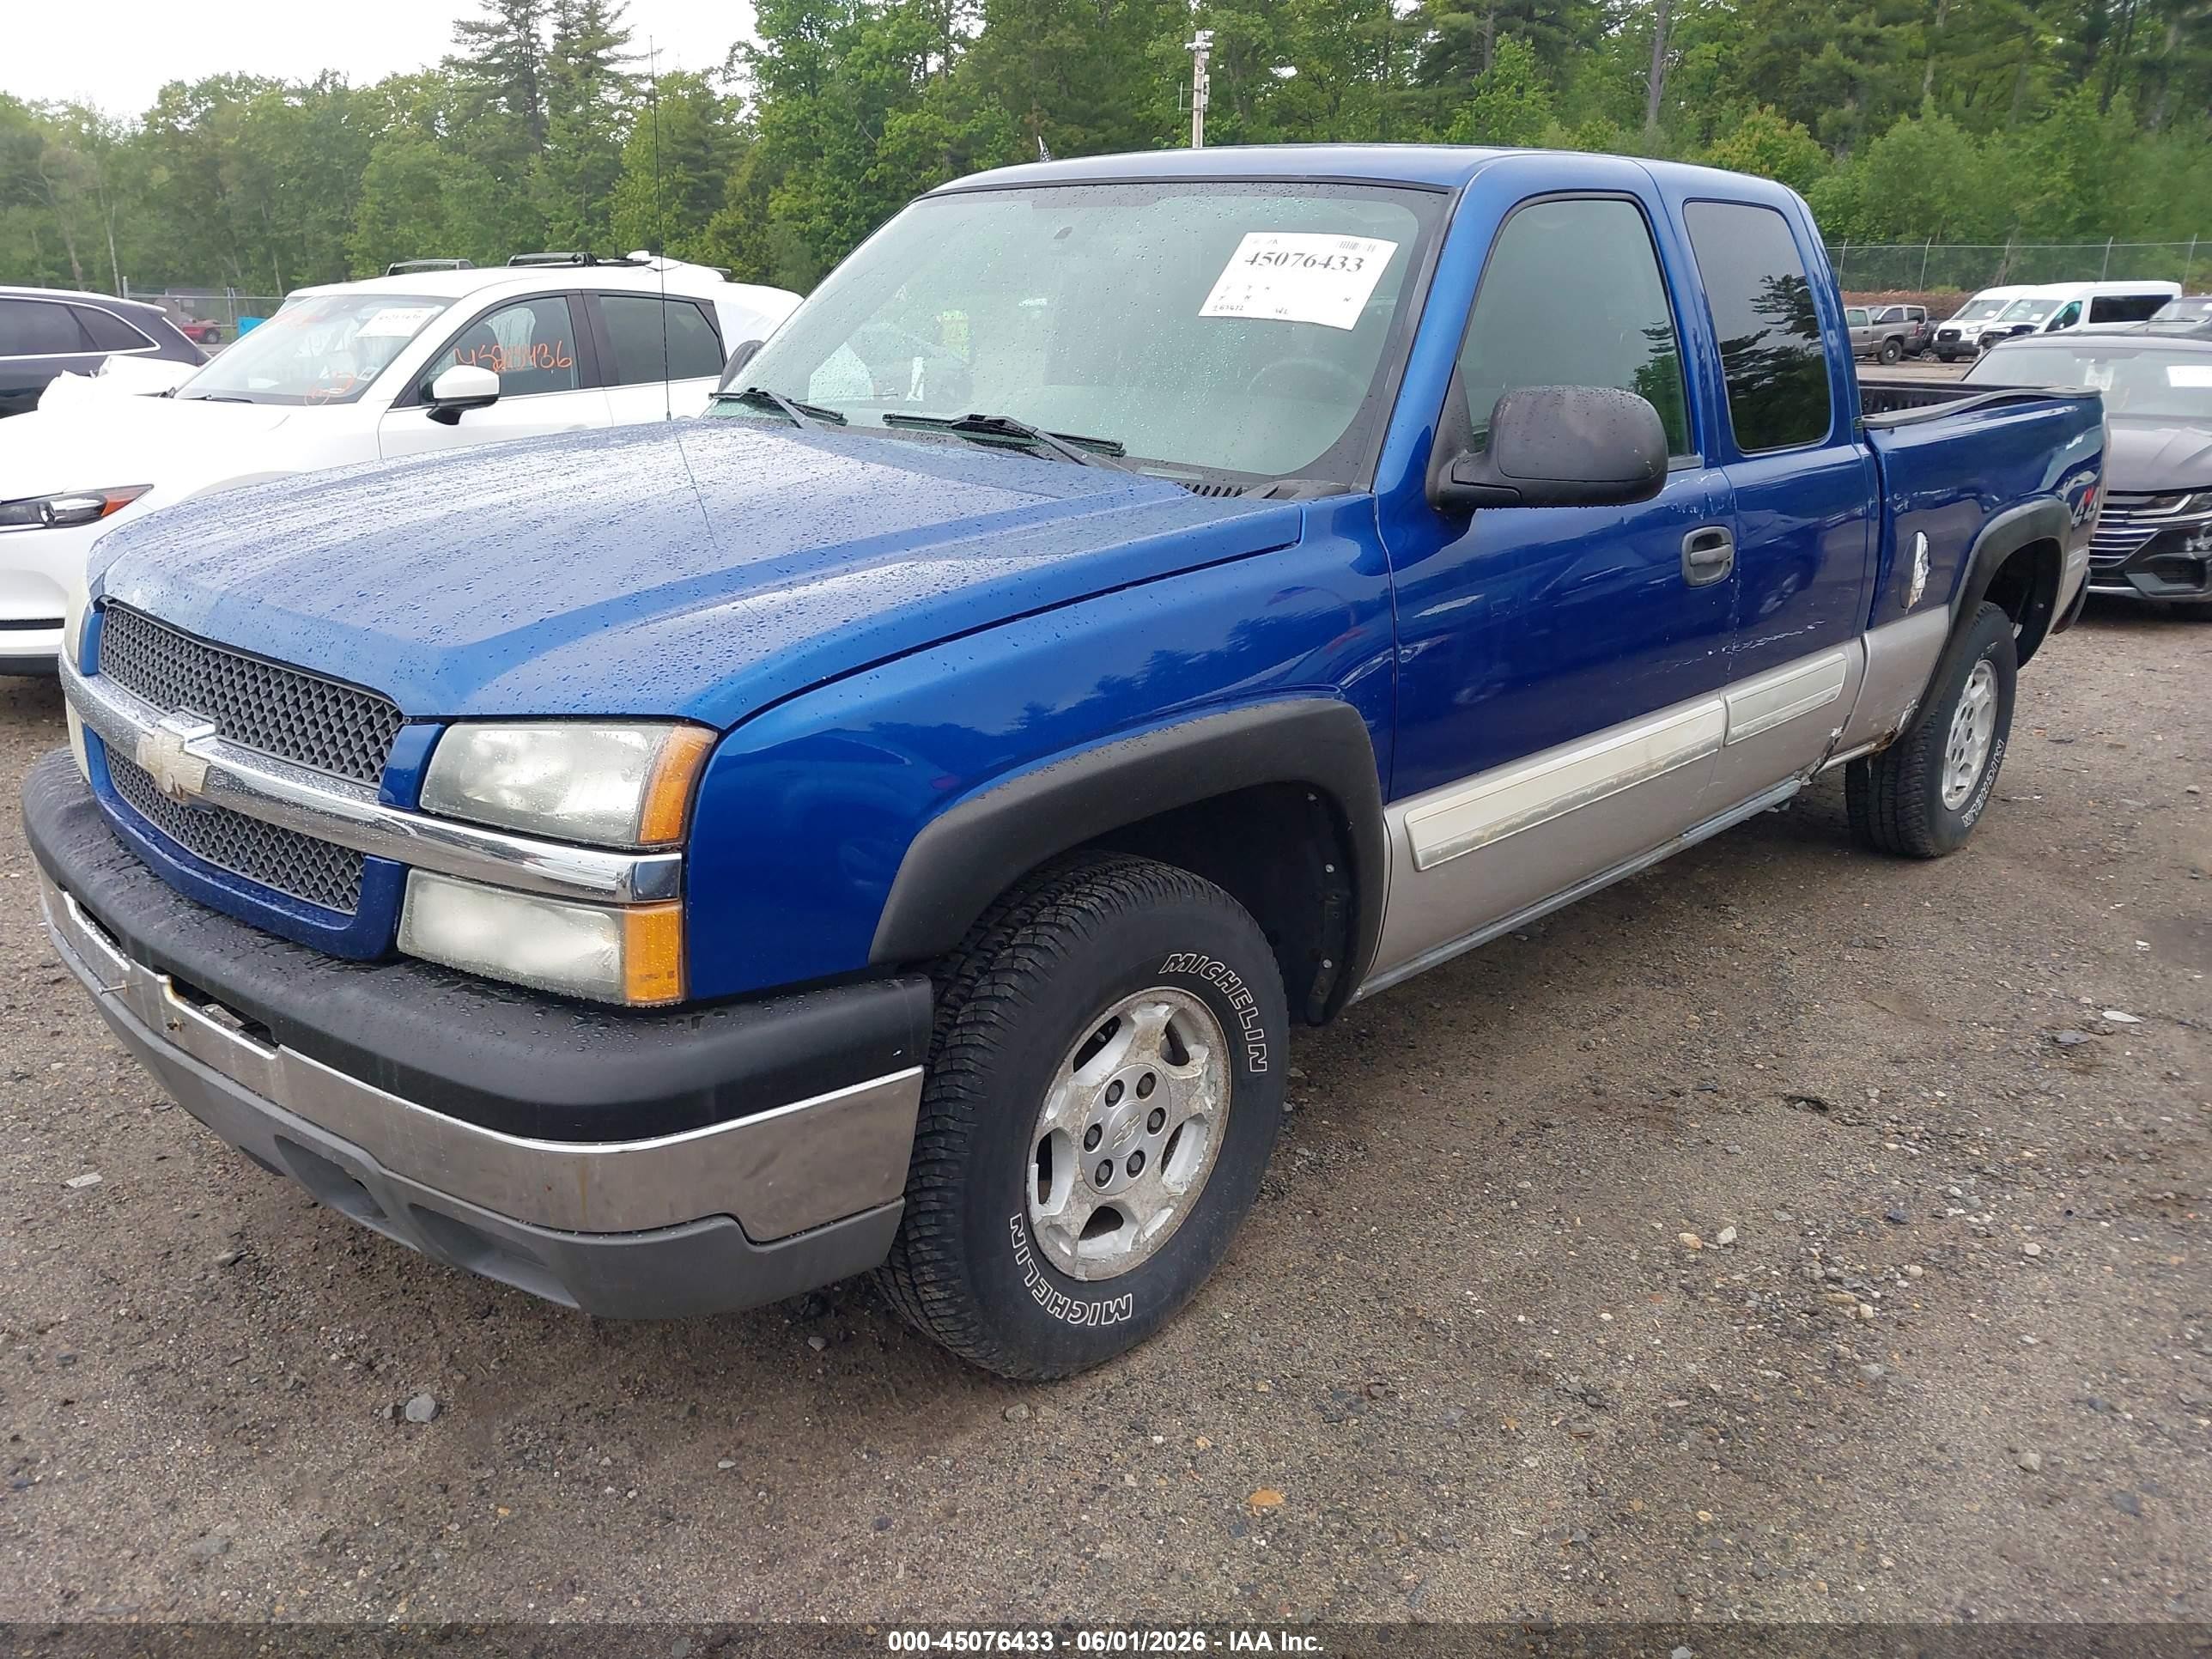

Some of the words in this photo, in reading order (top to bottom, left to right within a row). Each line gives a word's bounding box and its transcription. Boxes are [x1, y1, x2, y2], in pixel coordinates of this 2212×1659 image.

[1244, 252, 1365, 272] 45076433
[1961, 738, 2005, 828] MICHELIN
[1158, 952, 1269, 1073] MICHELIN
[1010, 1212, 1133, 1327] MICHELIN
